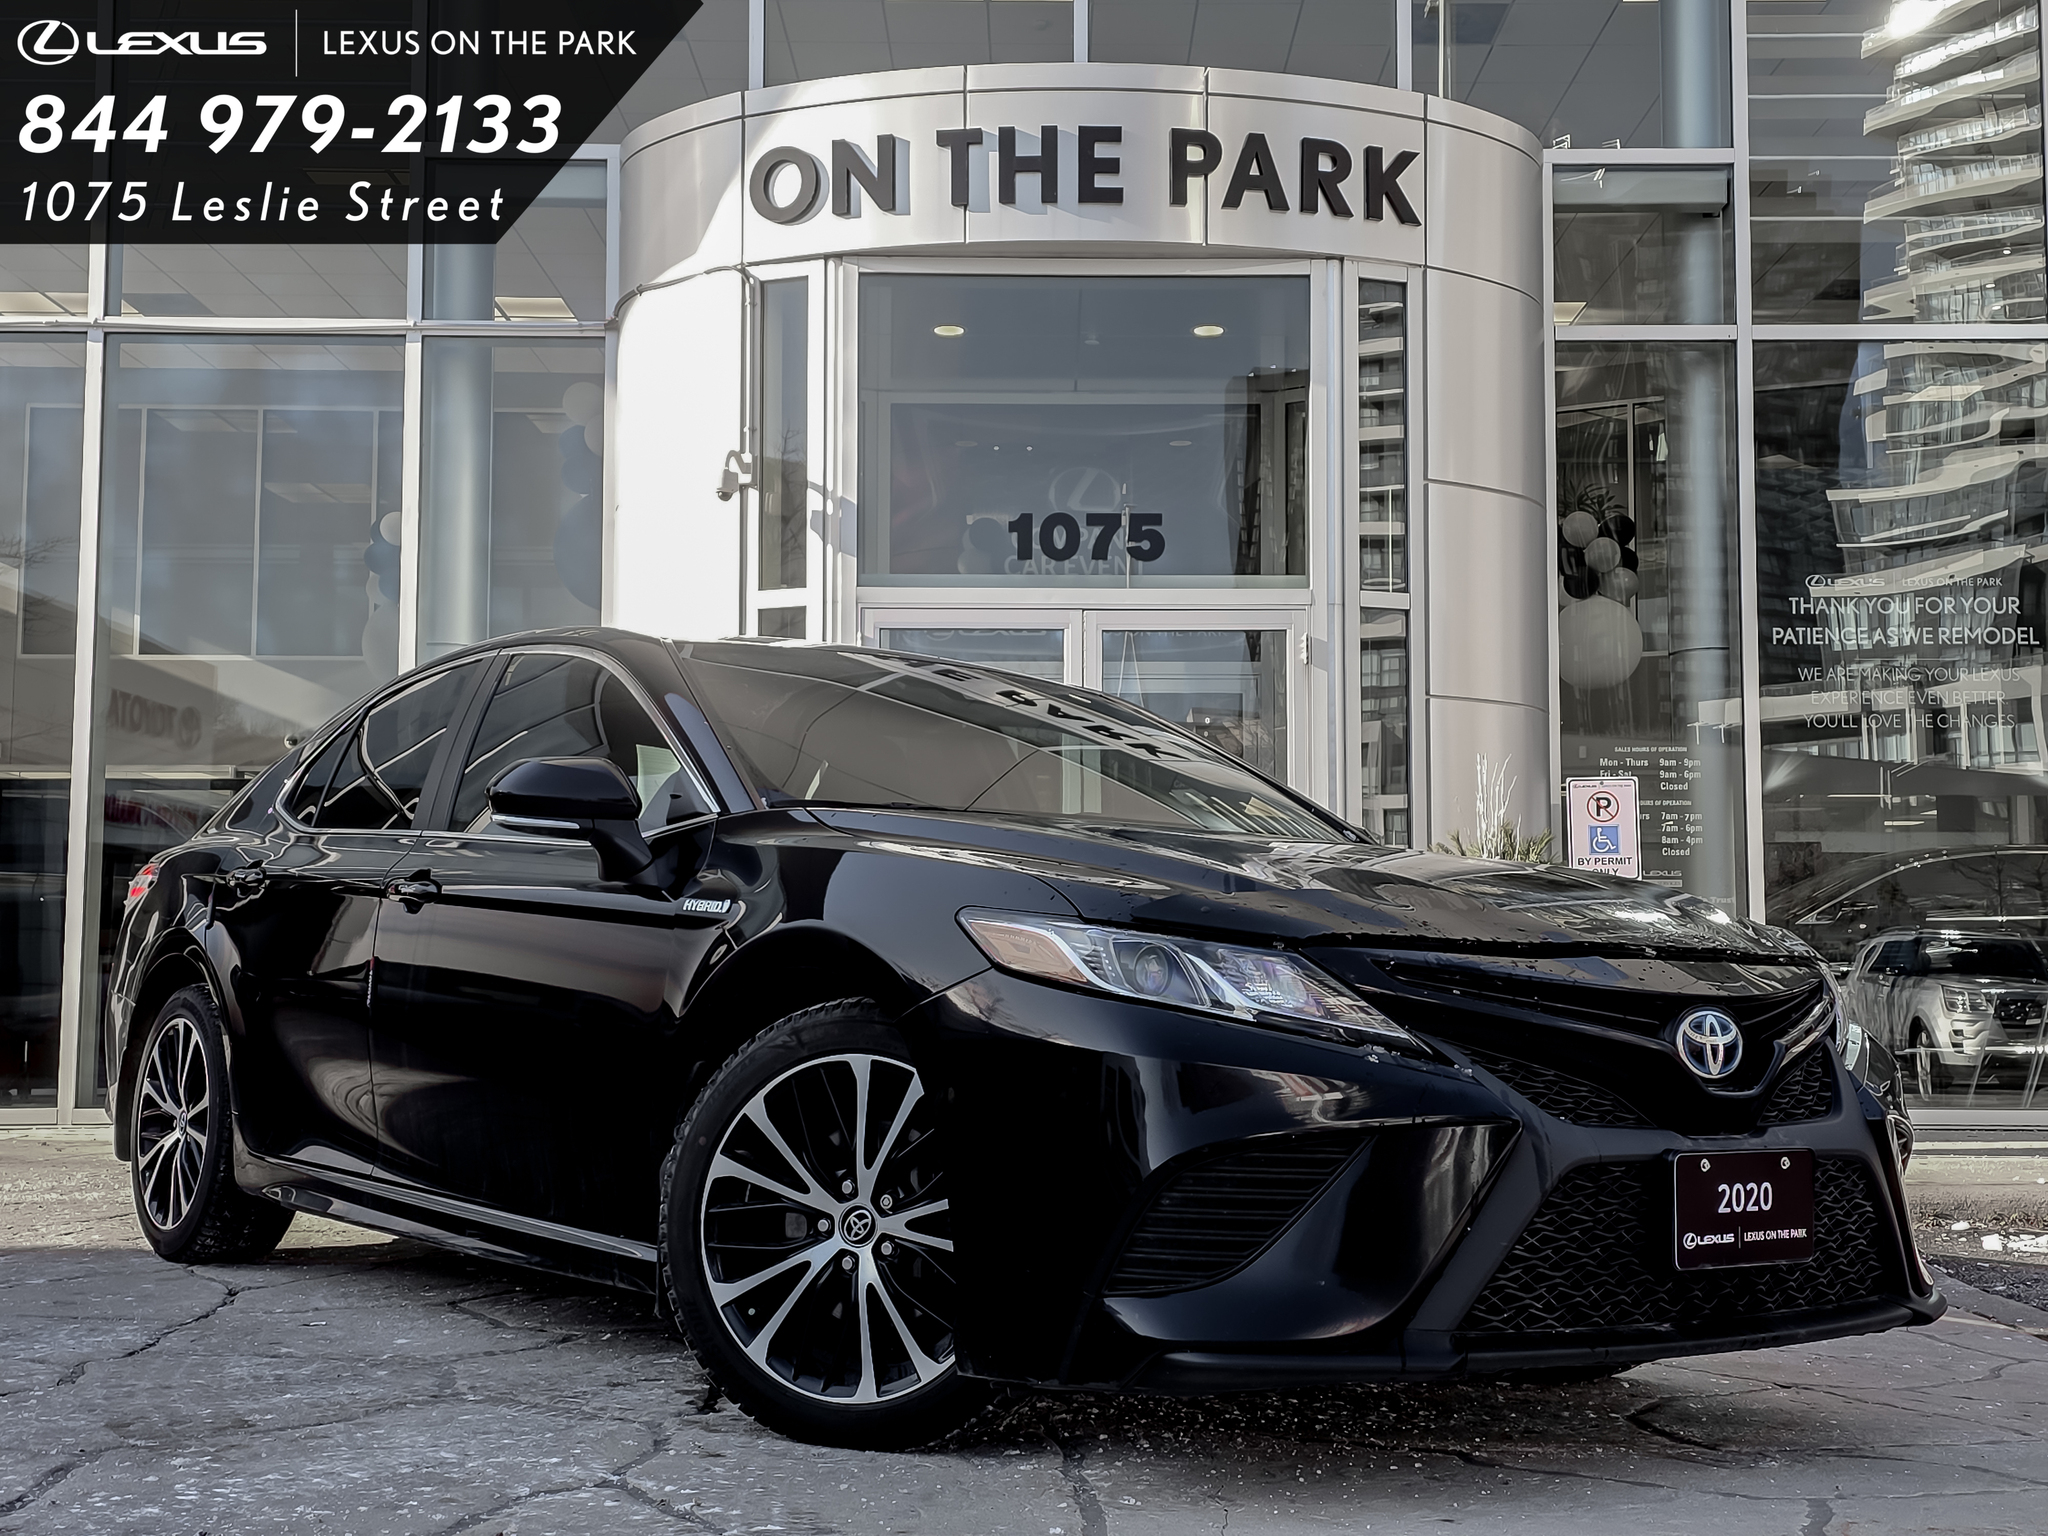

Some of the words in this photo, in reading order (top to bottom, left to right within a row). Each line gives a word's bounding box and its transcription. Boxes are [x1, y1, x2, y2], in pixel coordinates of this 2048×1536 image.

[749, 134, 905, 225] ON
[936, 124, 1125, 208] THE
[1169, 127, 1423, 228] PARK
[1008, 512, 1166, 562] 1075
[1827, 577, 1886, 587] LEXUS
[1902, 577, 1934, 587] LEXUS
[1936, 577, 1955, 587] ON
[1956, 577, 1974, 587] THE
[1976, 577, 2003, 587] PARK
[1788, 597, 1859, 615] THANK
[1863, 597, 1910, 615] YOU
[1915, 597, 1957, 615] FOR
[1960, 597, 2022, 615] YOUR
[1772, 626, 1869, 645] PATIENCE
[1872, 626, 1899, 645] AS
[1899, 626, 1934, 645] WE
[1938, 627, 2041, 645] REMODEL
[1797, 667, 1822, 683] WE
[1826, 667, 1854, 683] ARE
[1857, 667, 1921, 683] MAKING
[1924, 667, 1970, 683] YOUR
[1972, 667, 2021, 683] LEXUS
[1811, 690, 1902, 705] EXPERIENCE
[1909, 690, 1948, 705] EVEN
[1804, 713, 1858, 729] YOU'LL
[1861, 713, 1902, 729] LOVE
[1600, 758, 1619, 767] Mon
[1625, 758, 1649, 767] Thurs
[1659, 758, 1677, 767] 9am
[1683, 758, 1701, 768] 9pm
[1659, 770, 1677, 779] 9am
[1683, 770, 1701, 780] 6pm
[1660, 782, 1689, 791] Closed
[1661, 812, 1678, 820] 7am
[1684, 812, 1703, 822] 7pm
[1661, 824, 1678, 832] 7am
[1685, 824, 1703, 833] 6pm
[1661, 836, 1678, 844] 8am
[1685, 836, 1703, 845] 4pm
[1662, 847, 1691, 856] Closed
[1577, 857, 1592, 866] BY
[1594, 857, 1633, 865] PERMIT
[682, 899, 723, 913] HYBRID
[1717, 1181, 1773, 1214] 2020
[1697, 1233, 1735, 1245] LEXUS
[1744, 1230, 1765, 1242] LEXUS
[1765, 1230, 1777, 1240] ON
[1777, 1229, 1790, 1239] THE
[1790, 1228, 1808, 1239] PARK
